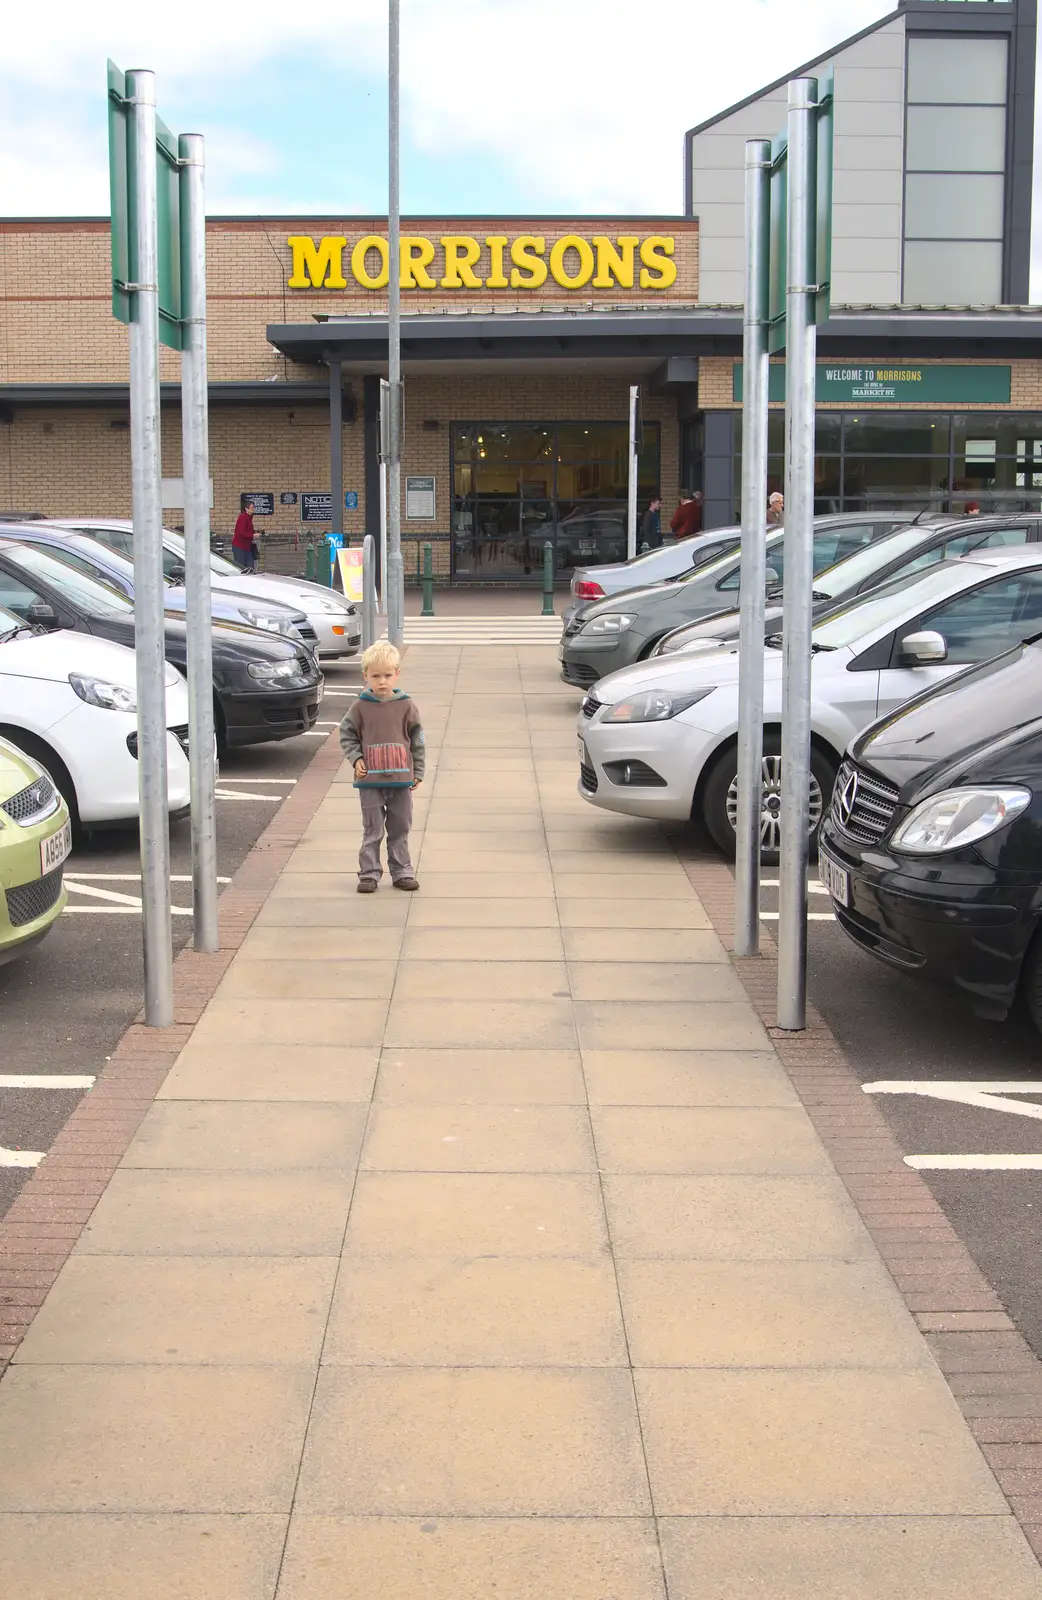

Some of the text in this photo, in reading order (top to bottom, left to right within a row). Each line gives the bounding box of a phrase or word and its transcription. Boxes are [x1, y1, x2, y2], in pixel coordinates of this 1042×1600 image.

[287, 234, 678, 290] MORRISONS
[826, 370, 922, 382] WELCOME TO MORRISONS
[304, 496, 332, 504] NOTIC
